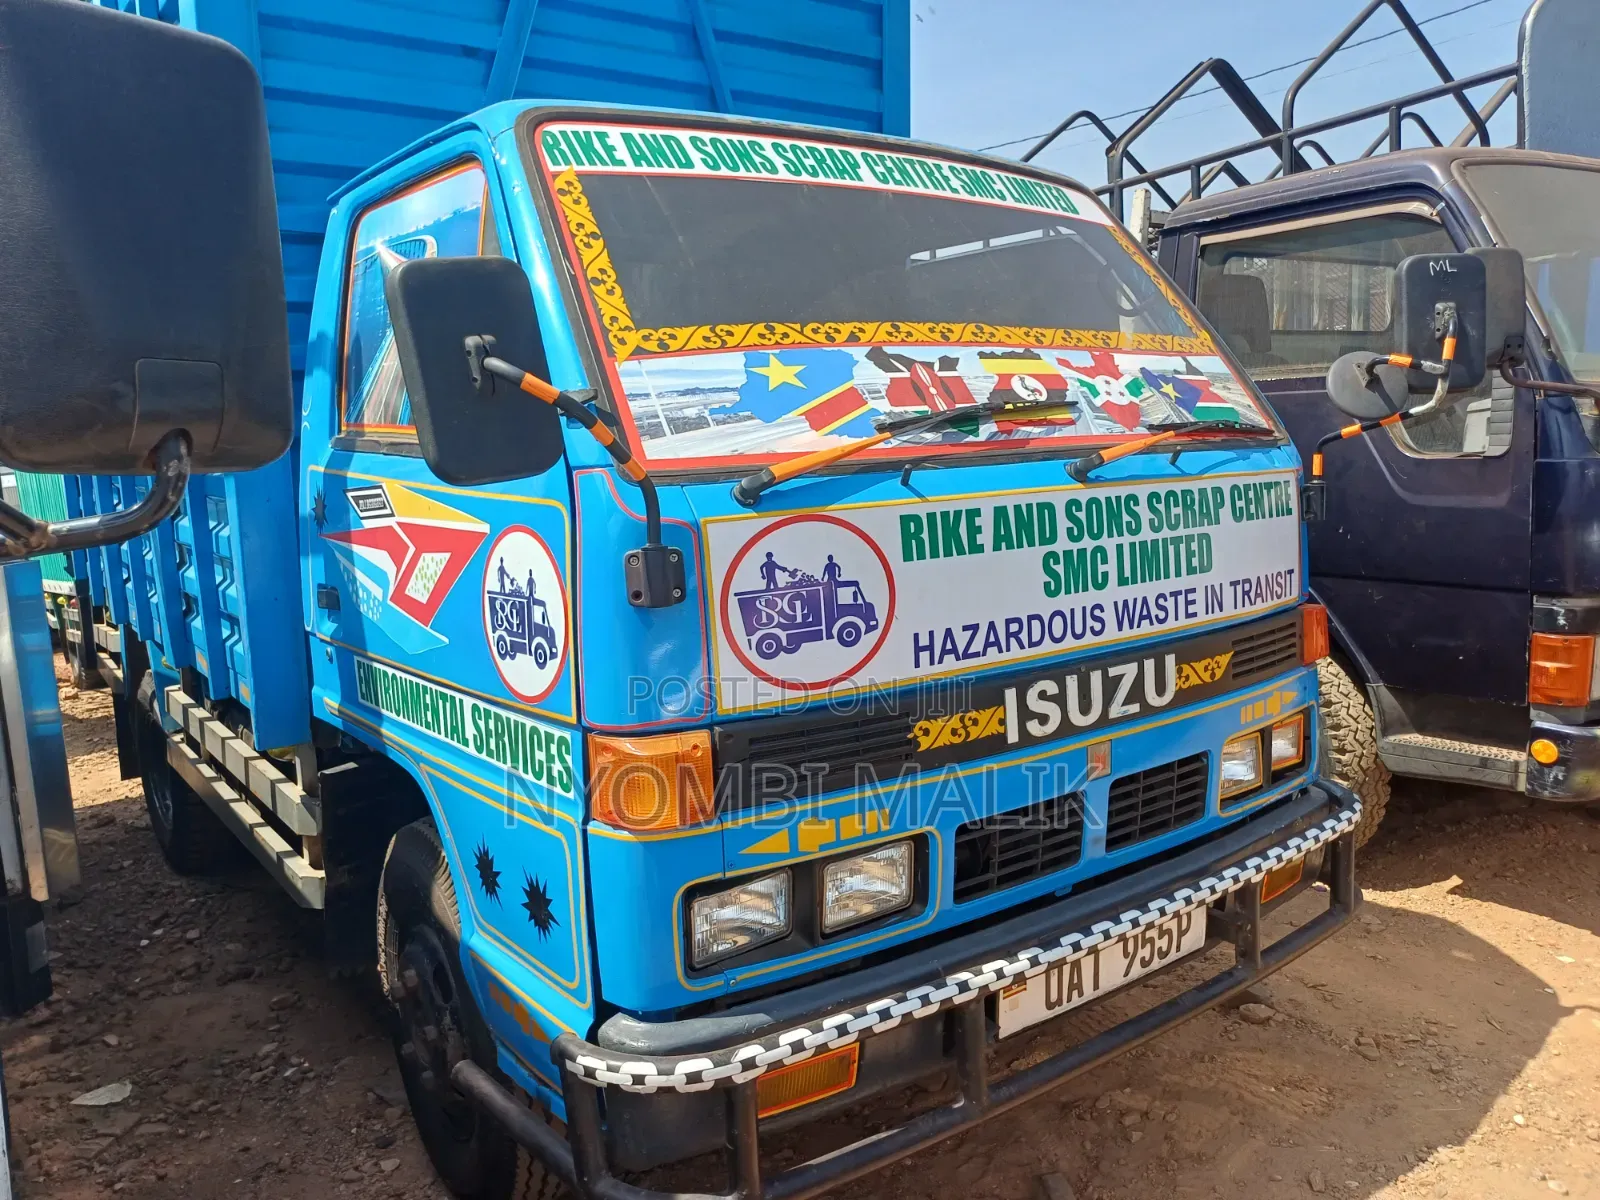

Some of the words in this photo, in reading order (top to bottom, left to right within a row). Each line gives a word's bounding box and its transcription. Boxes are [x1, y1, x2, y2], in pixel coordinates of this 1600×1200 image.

[541, 129, 626, 167] RIKE
[620, 132, 695, 170] AND
[689, 135, 779, 175] SONS
[771, 142, 864, 182] SCRAP
[861, 152, 960, 195] CENTRE
[948, 165, 1007, 202] SMC
[995, 174, 1080, 215] LIMITED
[1429, 259, 1457, 276] ML
[899, 507, 985, 562] RIKE
[992, 501, 1058, 552] AND
[1065, 493, 1142, 543] SONS
[1147, 486, 1225, 534] SCRAP
[1230, 480, 1293, 523] CENTRE
[1042, 545, 1109, 598] SMC
[1116, 532, 1213, 587] LIMITED
[913, 603, 1106, 669] HAZARDOUS
[1113, 587, 1198, 632] WASTE
[1204, 583, 1224, 615] IN
[1229, 569, 1295, 610] TRANSIT
[356, 659, 469, 748] ENVIRONMENTAL
[471, 703, 573, 794] SERVICES
[1003, 653, 1176, 744] ISUZU
[1122, 910, 1192, 978] 955P
